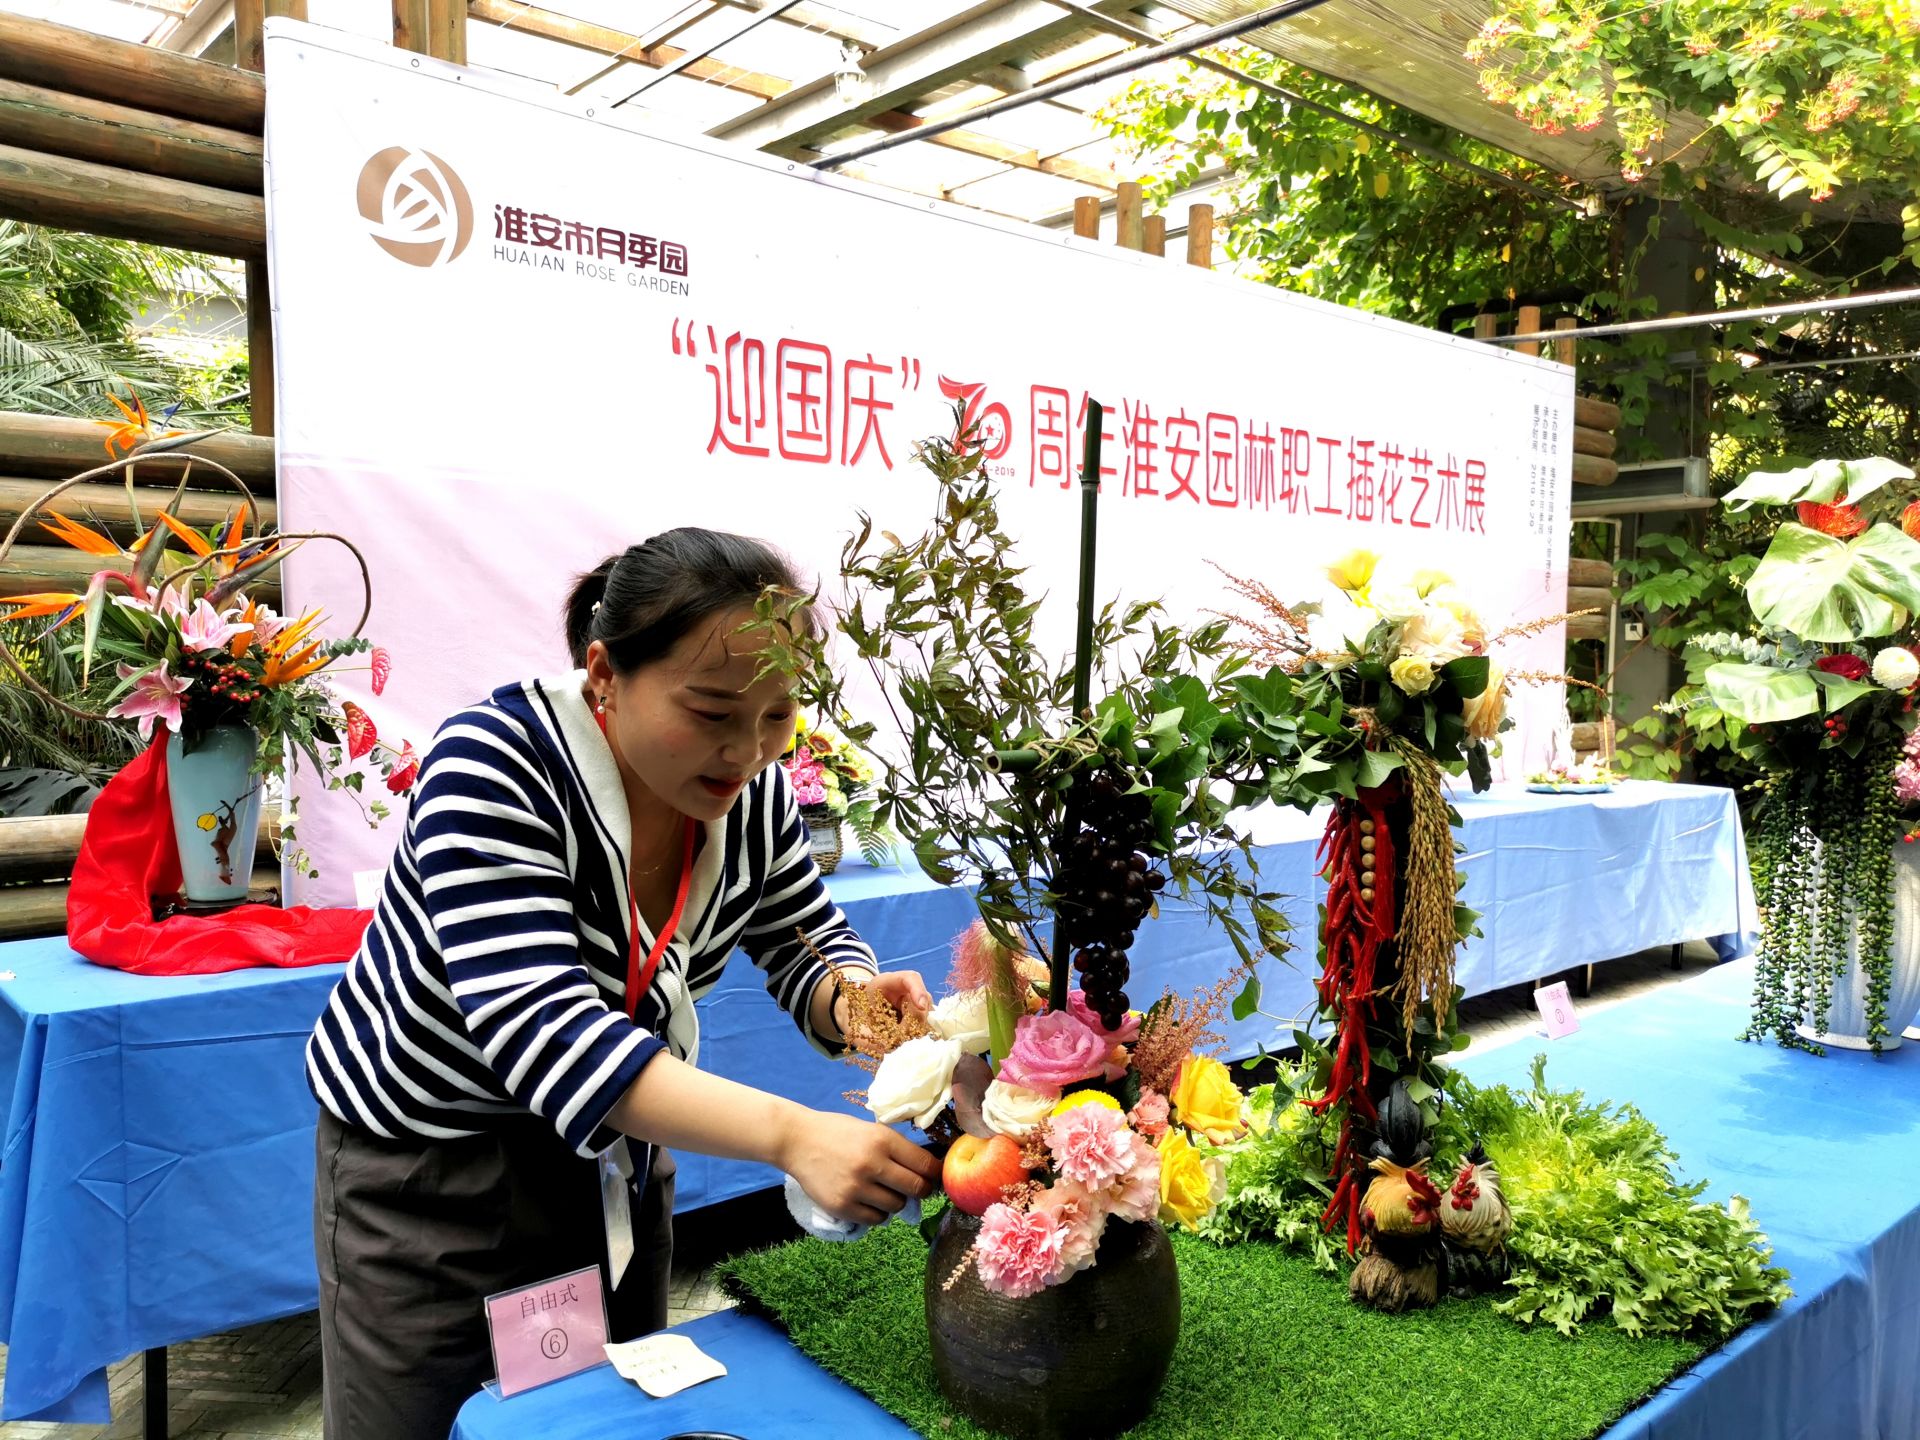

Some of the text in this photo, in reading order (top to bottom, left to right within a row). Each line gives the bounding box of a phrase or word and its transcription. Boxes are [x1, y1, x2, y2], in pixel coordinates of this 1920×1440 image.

[494, 204, 688, 277] 淮安市月季园
[494, 245, 689, 297] HUAIAN ROSE GARDEN
[520, 1282, 579, 1319] 自由式
